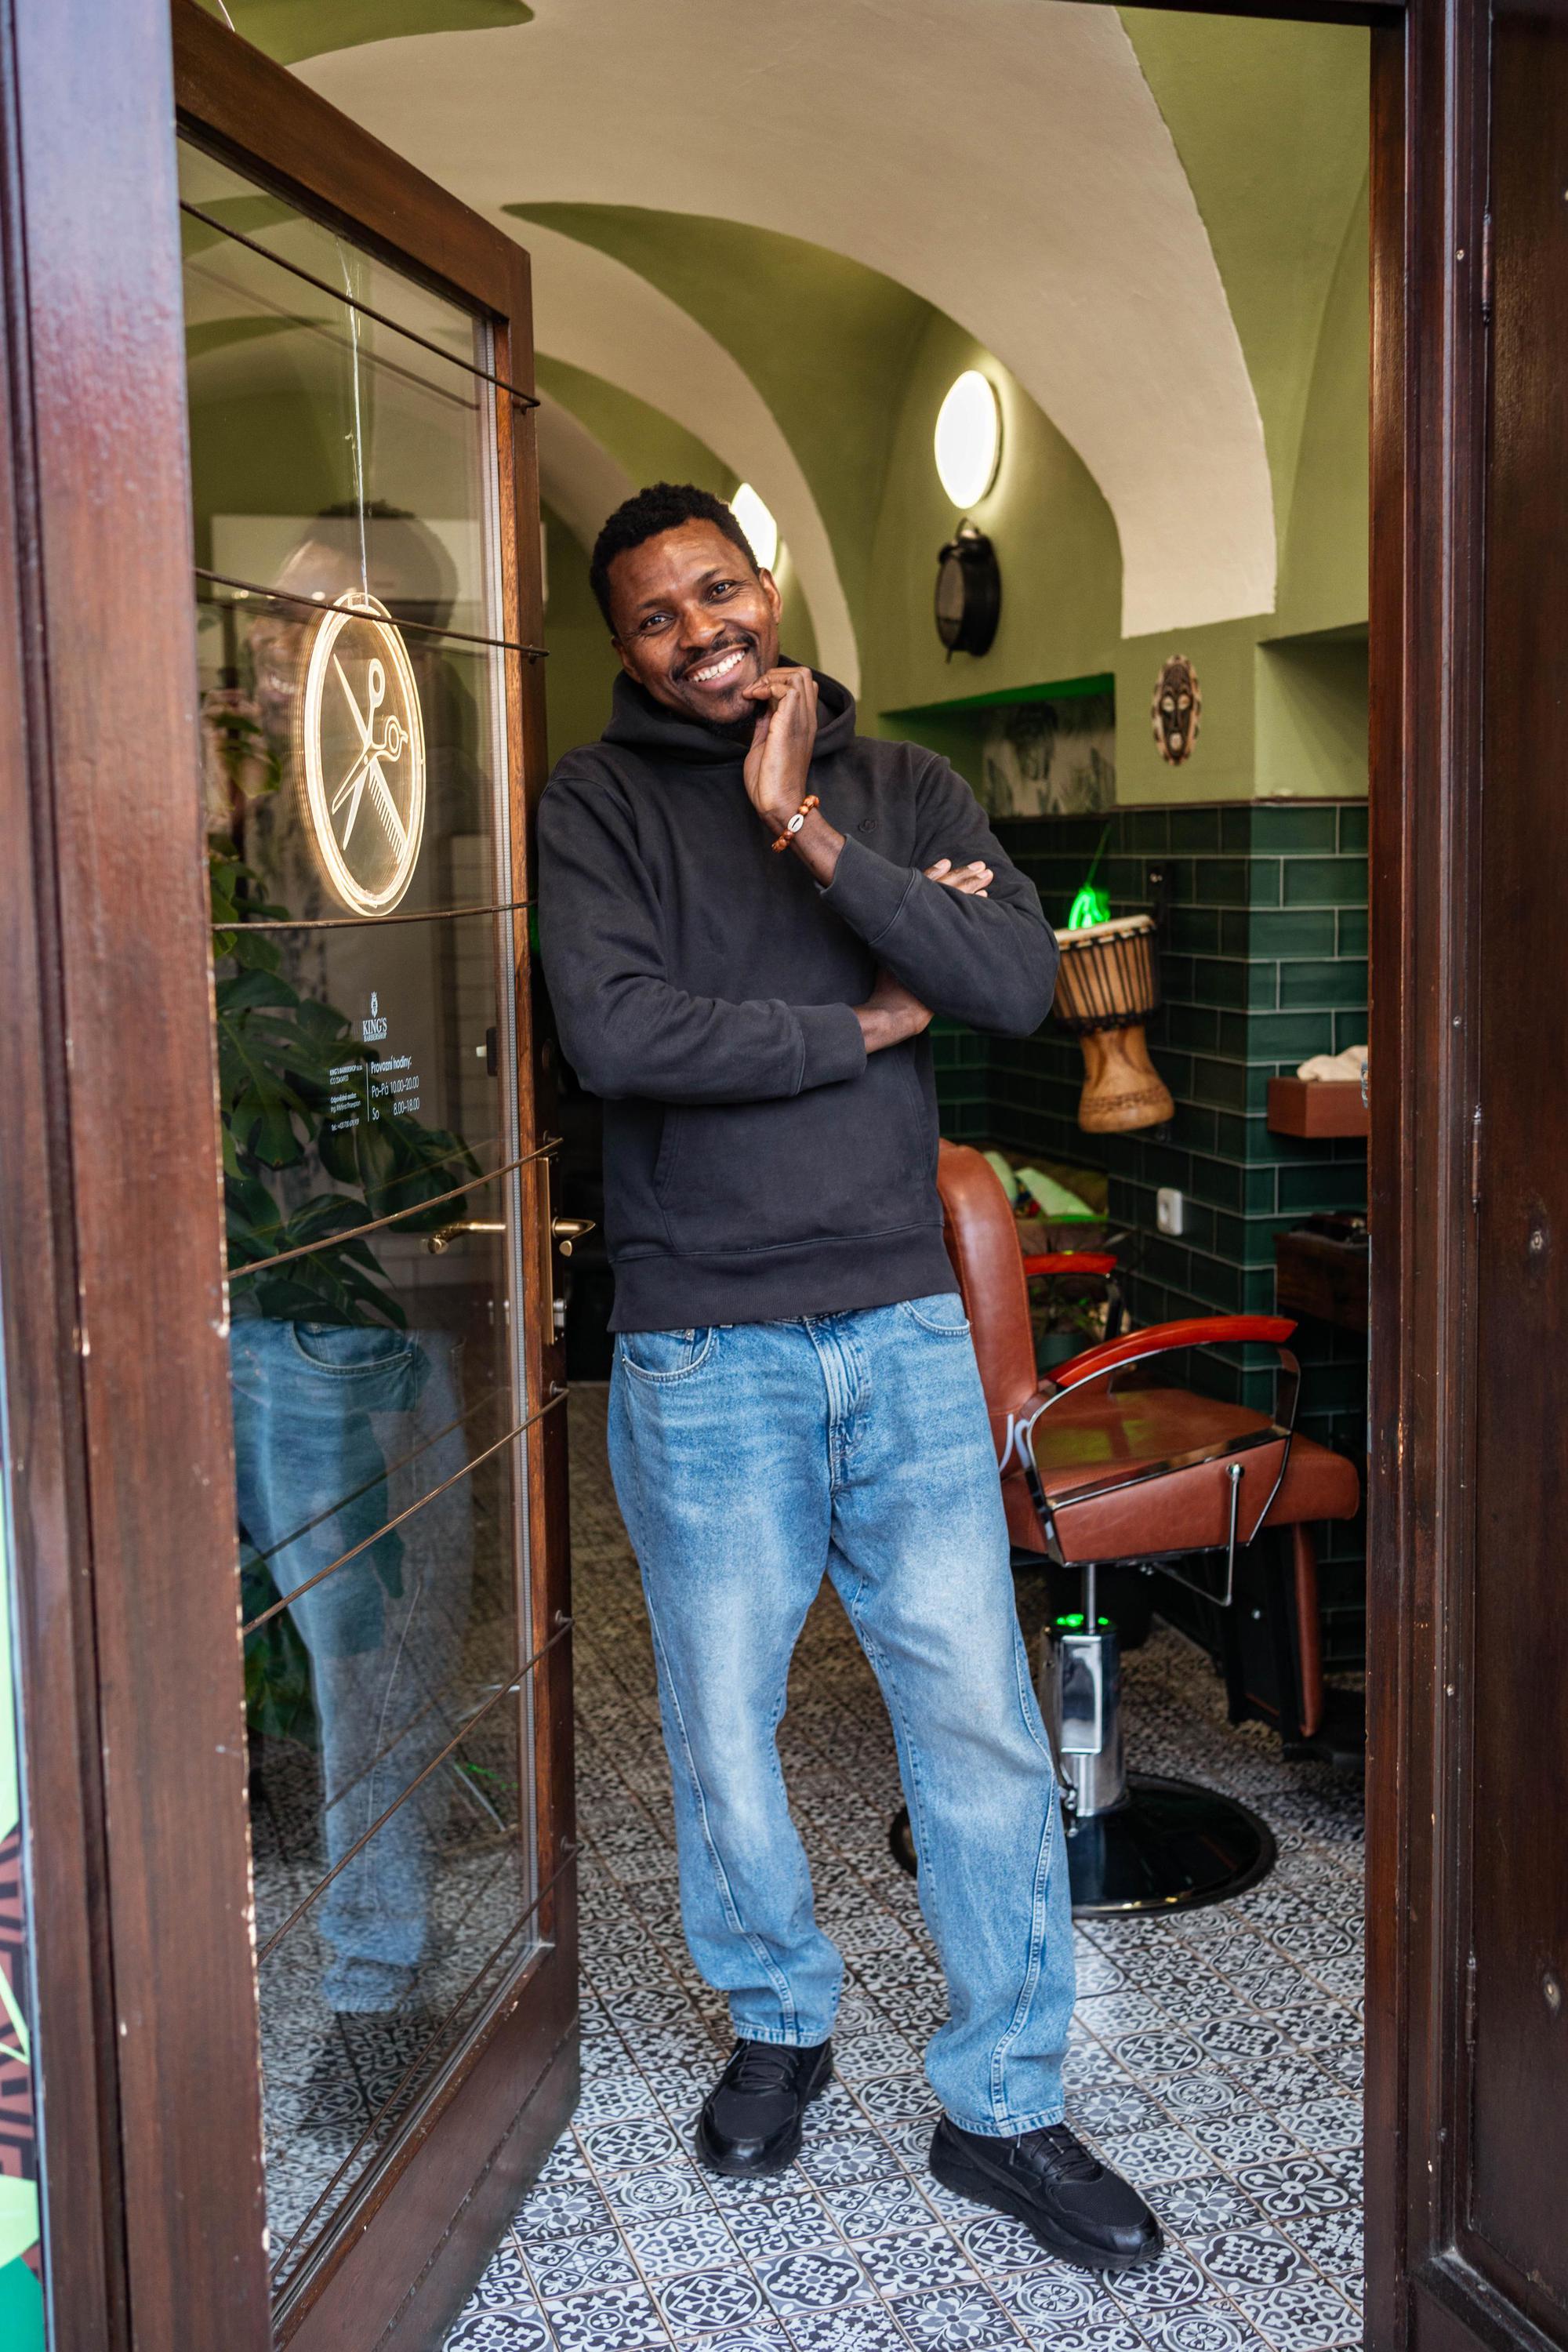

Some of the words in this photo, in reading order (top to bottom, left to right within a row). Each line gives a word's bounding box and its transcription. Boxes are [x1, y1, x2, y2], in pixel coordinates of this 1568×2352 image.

[363, 1018, 387, 1035] KING'S
[371, 1055, 393, 1074] Provozní
[372, 1107, 379, 1121] So
